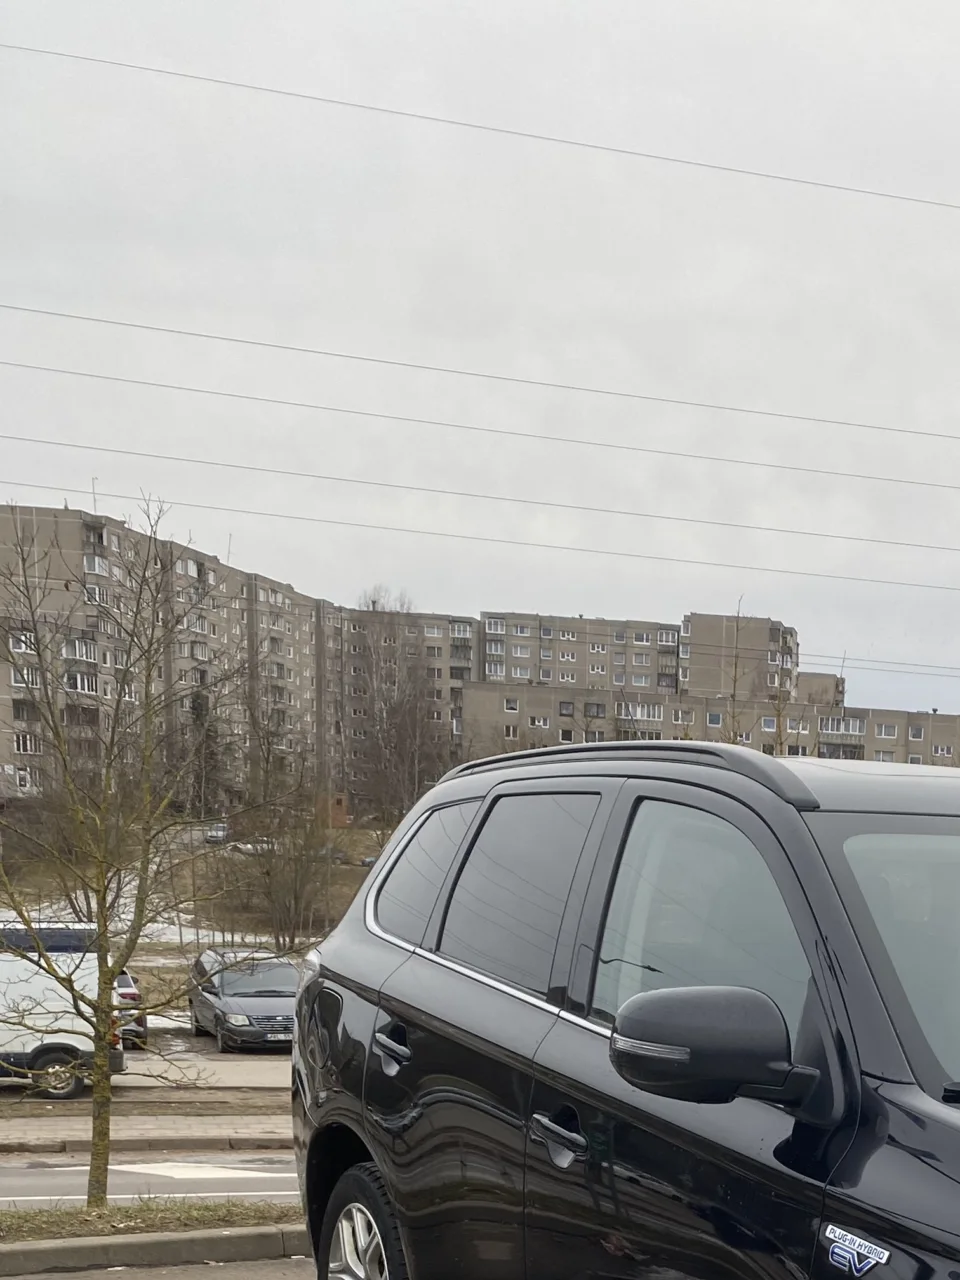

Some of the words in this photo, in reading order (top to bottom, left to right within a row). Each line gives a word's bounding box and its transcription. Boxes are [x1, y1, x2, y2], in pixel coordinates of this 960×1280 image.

[829, 1228, 857, 1247] PLUG-IN
[857, 1241, 885, 1260] HYBRID
[829, 1243, 877, 1277] EV
